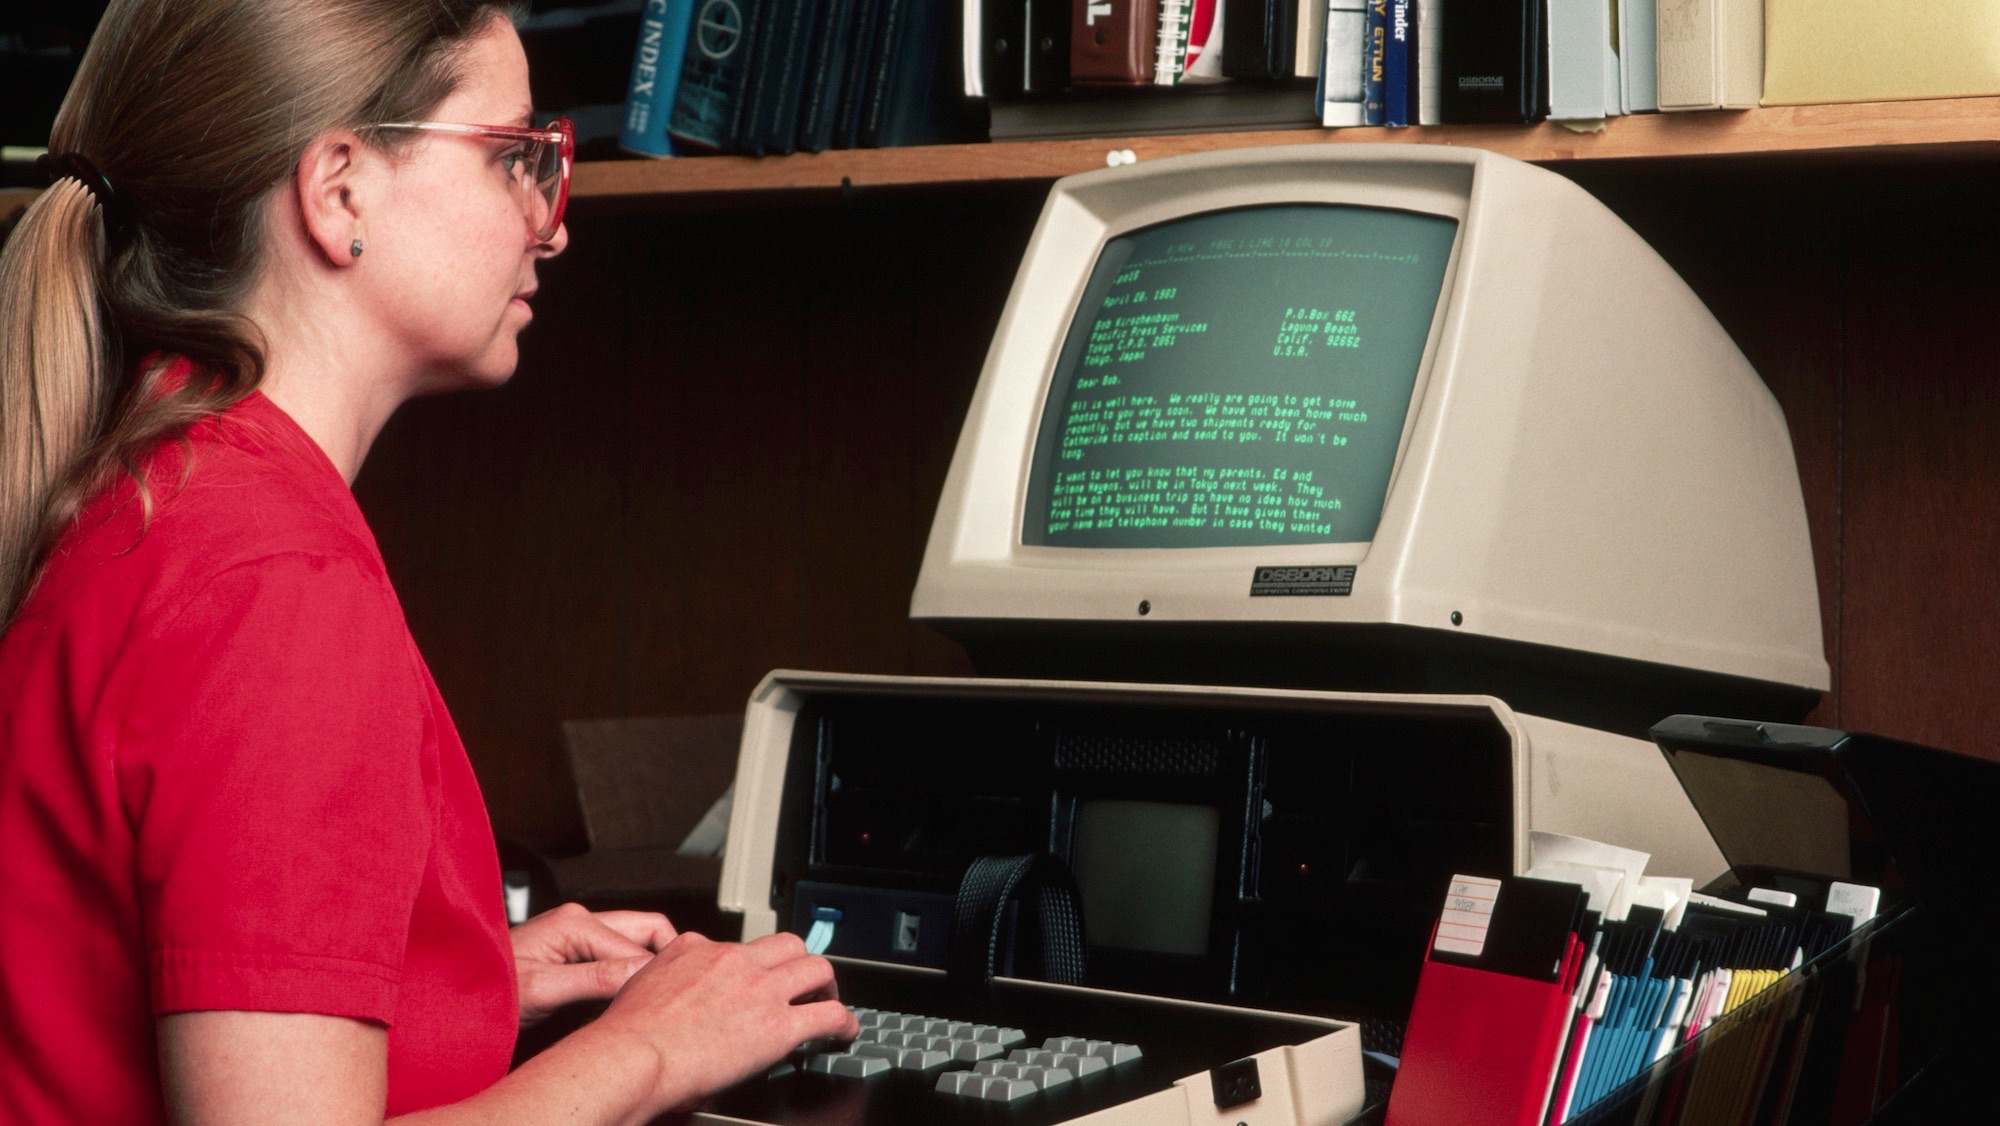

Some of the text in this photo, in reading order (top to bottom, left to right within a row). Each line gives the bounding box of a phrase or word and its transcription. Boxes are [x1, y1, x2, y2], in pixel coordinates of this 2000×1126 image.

[1087, 0, 1112, 26] L
[1374, 0, 1386, 16] Y
[633, 20, 664, 96] INDEX
[1458, 76, 1504, 85] OSBORNE
[1210, 239, 1234, 249] PAGE
[1102, 295, 1129, 307] April
[1334, 311, 1355, 322] 662
[1090, 322, 1207, 341] Pacific Press Services
[1092, 319, 1111, 331] Bob
[1279, 322, 1357, 336] Laguna Beach
[1275, 334, 1361, 348] Calif. 92652
[1086, 342, 1113, 356] Tokyo
[1272, 345, 1309, 357] U.S.A.
[1118, 351, 1145, 362] Japan
[1076, 378, 1098, 390] Dear
[1070, 393, 1356, 411] All is well here. We really are going to get some
[1067, 405, 1367, 425] photos to you very soon. We have not been home much
[1113, 420, 1130, 431] but
[1135, 421, 1147, 429] we
[1151, 418, 1175, 429] have
[1179, 418, 1197, 428] two
[1203, 418, 1254, 431] shipments
[1259, 418, 1291, 432] ready
[1296, 420, 1315, 431] for
[1062, 433, 1108, 447] Catherine
[1111, 432, 1124, 442] to
[1127, 430, 1167, 443] caption
[1171, 430, 1190, 440] and
[1193, 430, 1218, 440] send
[1221, 430, 1235, 440] to
[1237, 433, 1262, 443] you.
[1274, 431, 1289, 442] It
[1331, 435, 1348, 446] be
[1062, 447, 1085, 460] long.
[1065, 471, 1085, 482] want
[1089, 470, 1101, 481] to
[1105, 469, 1120, 479] let
[1124, 471, 1142, 480] you
[1146, 467, 1171, 477] know
[1175, 467, 1197, 477] that
[1202, 469, 1215, 479] my
[1272, 468, 1287, 479] Ed
[1291, 470, 1313, 481] and
[1053, 483, 1084, 495] Arlene
[1128, 479, 1150, 490] will
[1155, 479, 1168, 489] be
[1172, 479, 1185, 489] in
[1190, 478, 1218, 491] Tokyo
[1223, 479, 1246, 489] next
[1252, 481, 1282, 491] week.
[1296, 482, 1324, 497] They
[1051, 491, 1342, 509] will be on a business trip so have no idea how much
[1050, 507, 1071, 518] free
[1074, 507, 1095, 517] time
[1098, 505, 1121, 518] they
[1124, 504, 1147, 514] will
[1151, 503, 1179, 514] have.
[1190, 503, 1207, 514] But
[1224, 504, 1249, 515] have
[1253, 507, 1286, 519] given
[1292, 508, 1320, 520] them
[1047, 516, 1331, 534] your name and telephone number in case they wanted
[1258, 567, 1354, 582] OSBORNE
